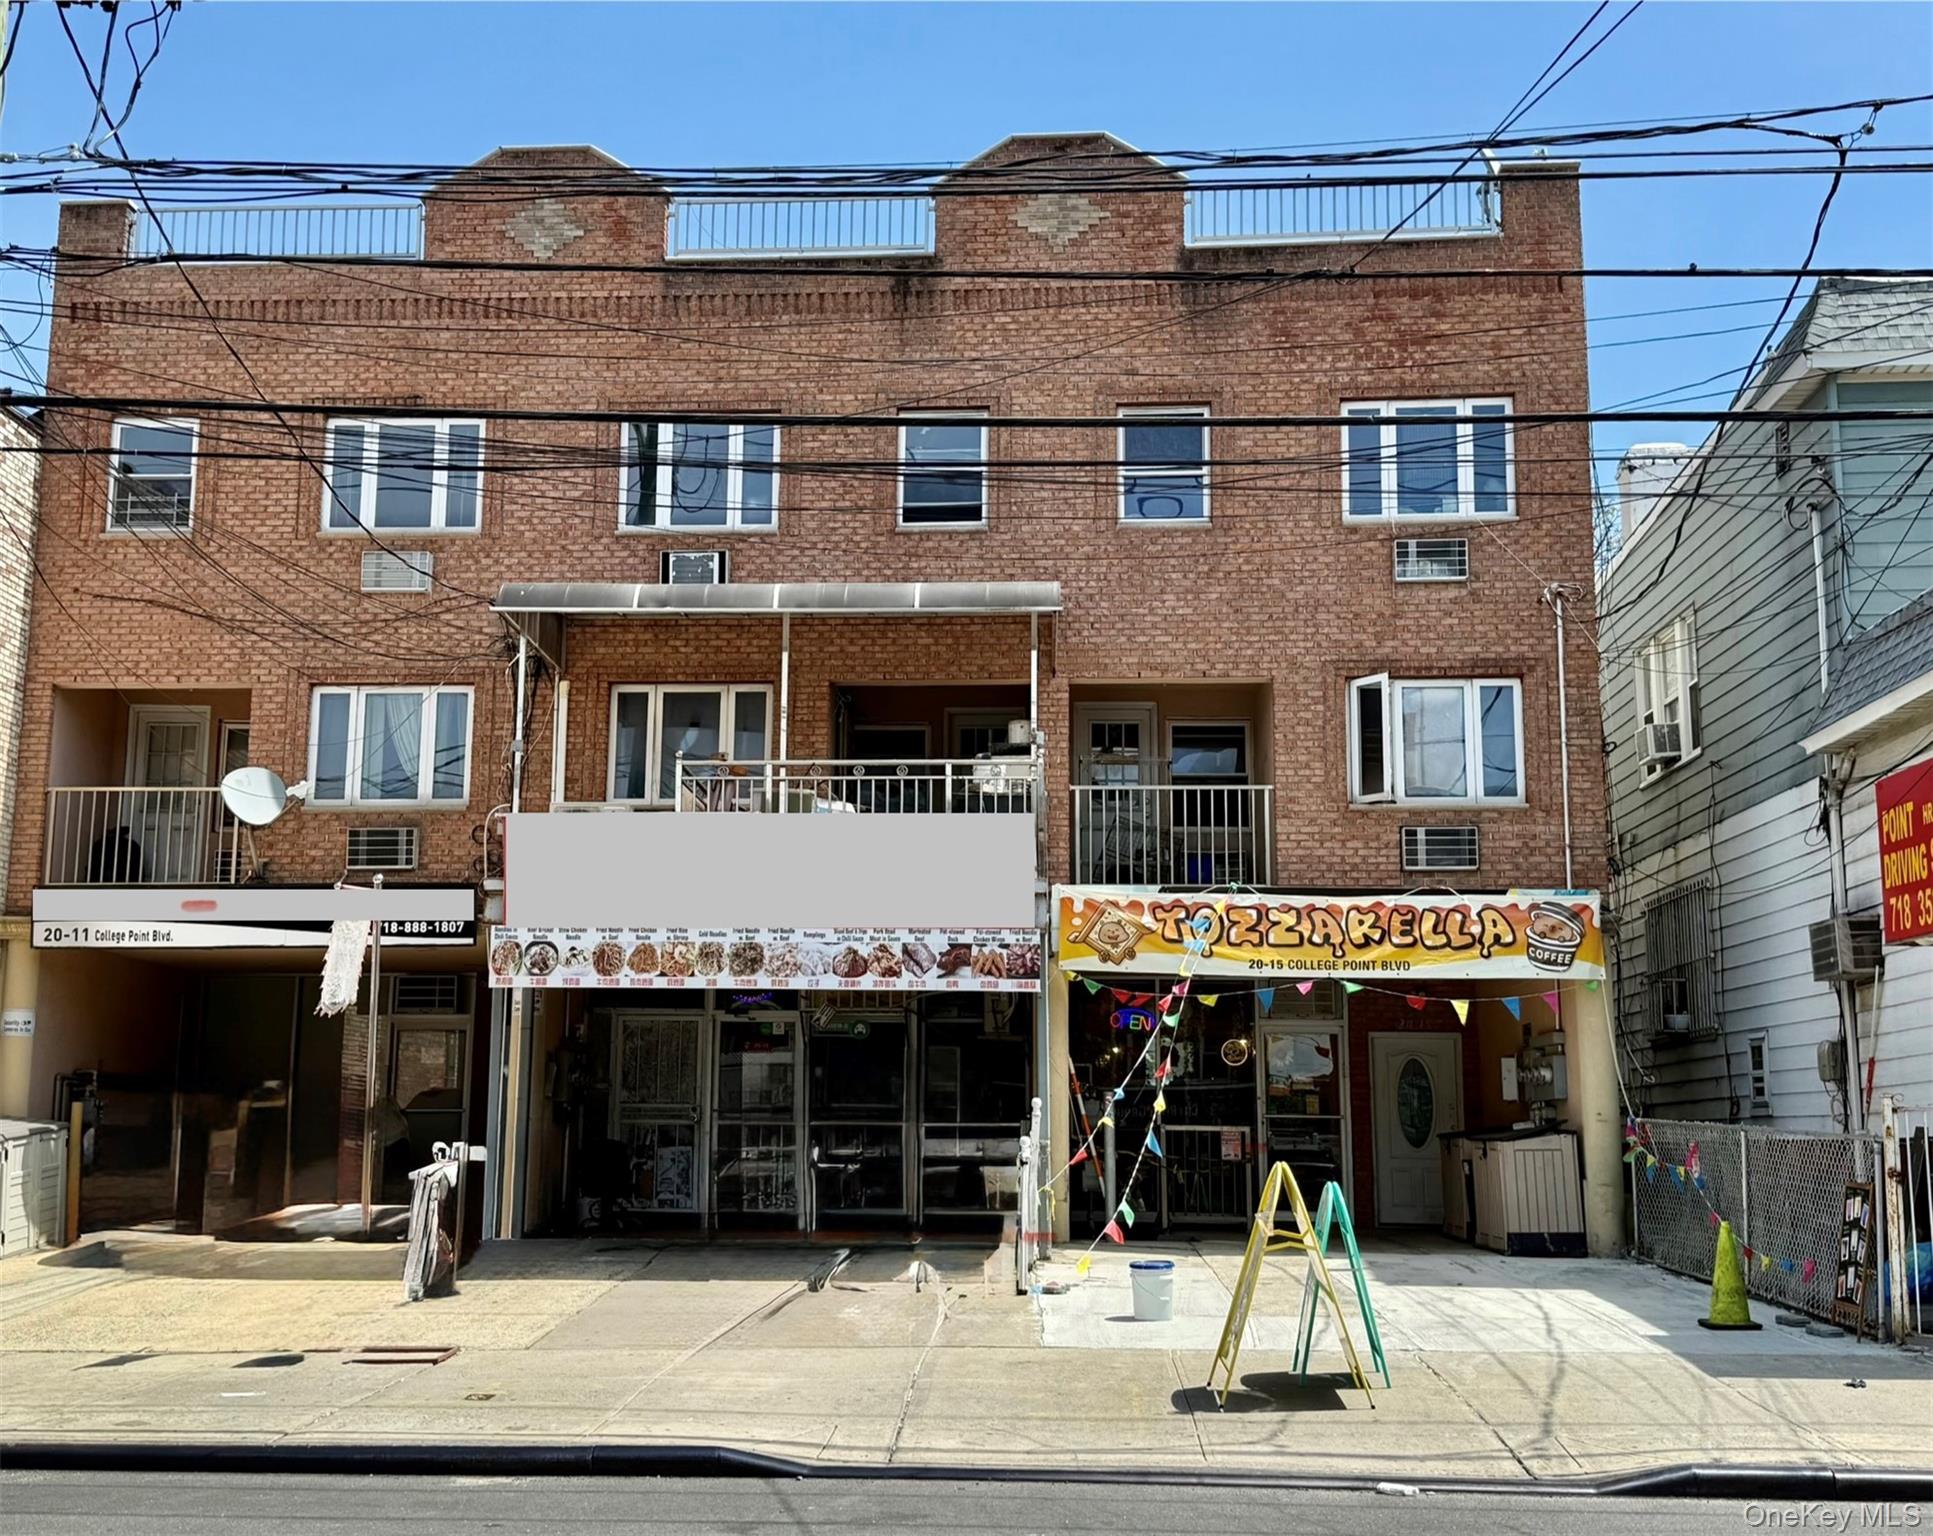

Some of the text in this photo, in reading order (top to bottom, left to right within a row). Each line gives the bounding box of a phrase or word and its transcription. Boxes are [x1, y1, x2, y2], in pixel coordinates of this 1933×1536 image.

[1882, 801, 1914, 845] POINT
[1883, 843, 1927, 889] DRIVING
[1889, 887, 1933, 933] 718 35
[43, 927, 173, 944] 20-11 College Point Blvd.
[380, 921, 465, 933] 18-888-1807
[1153, 905, 1516, 959] TOZZARELLA
[1528, 946, 1572, 965] COFFEE
[1248, 959, 1411, 972] 20-15 COLLEGE POINT BLVD
[1110, 1012, 1152, 1031] OPEN
